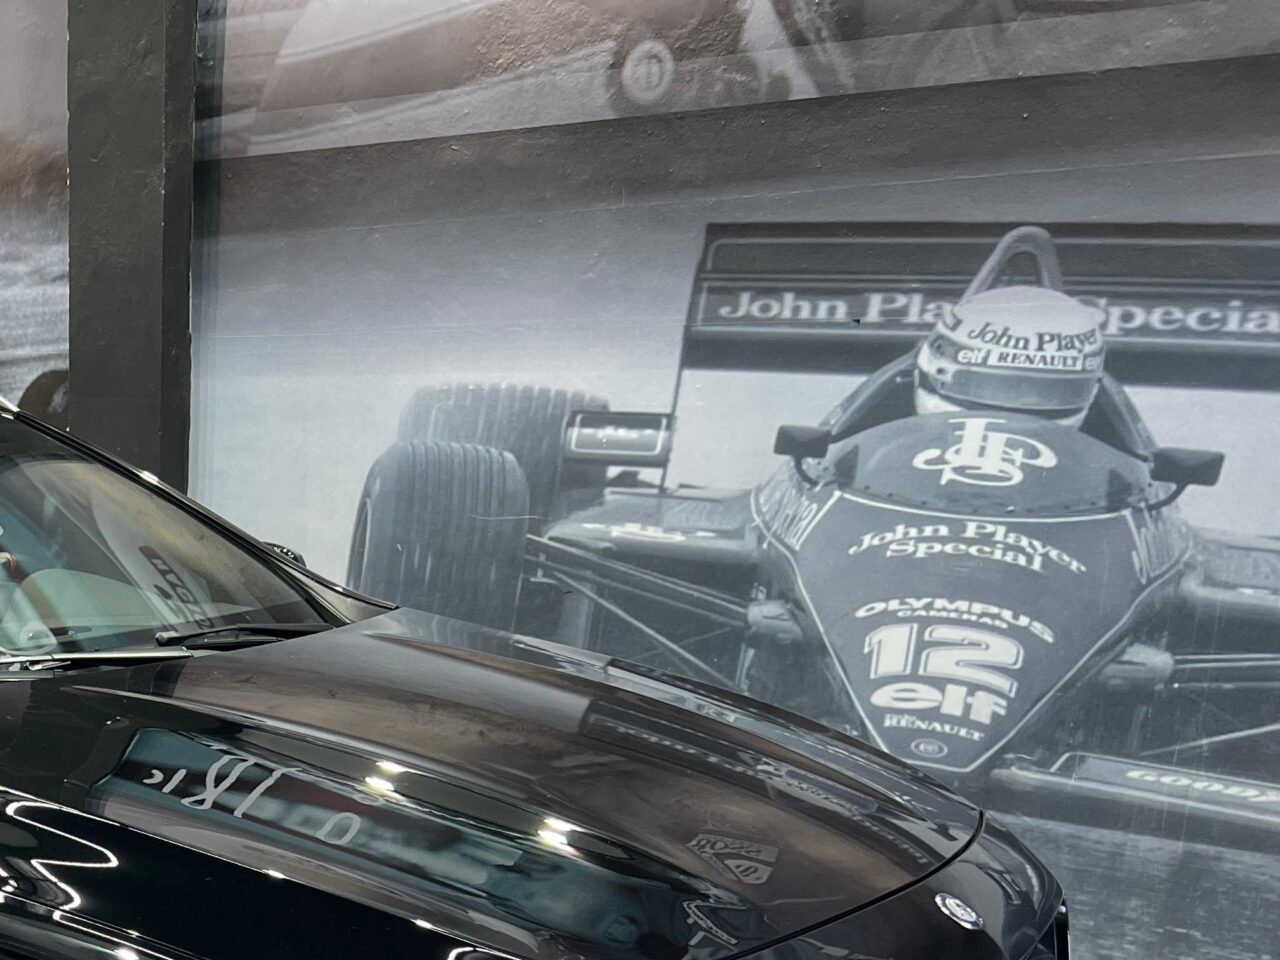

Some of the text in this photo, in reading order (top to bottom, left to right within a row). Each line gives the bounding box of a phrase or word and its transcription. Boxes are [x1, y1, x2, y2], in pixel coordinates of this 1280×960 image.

[719, 291, 1280, 335] John Pla pecia
[969, 321, 1031, 350] John
[996, 351, 1080, 368] RENAULT
[848, 523, 951, 555] John
[963, 521, 1088, 574] Player
[886, 539, 1046, 573] Special
[855, 598, 1055, 644] OLYMPUS
[896, 610, 1009, 630] CAMERAS
[863, 623, 1024, 698] 12
[870, 682, 1008, 725] elf
[883, 713, 986, 741] RENAULT
